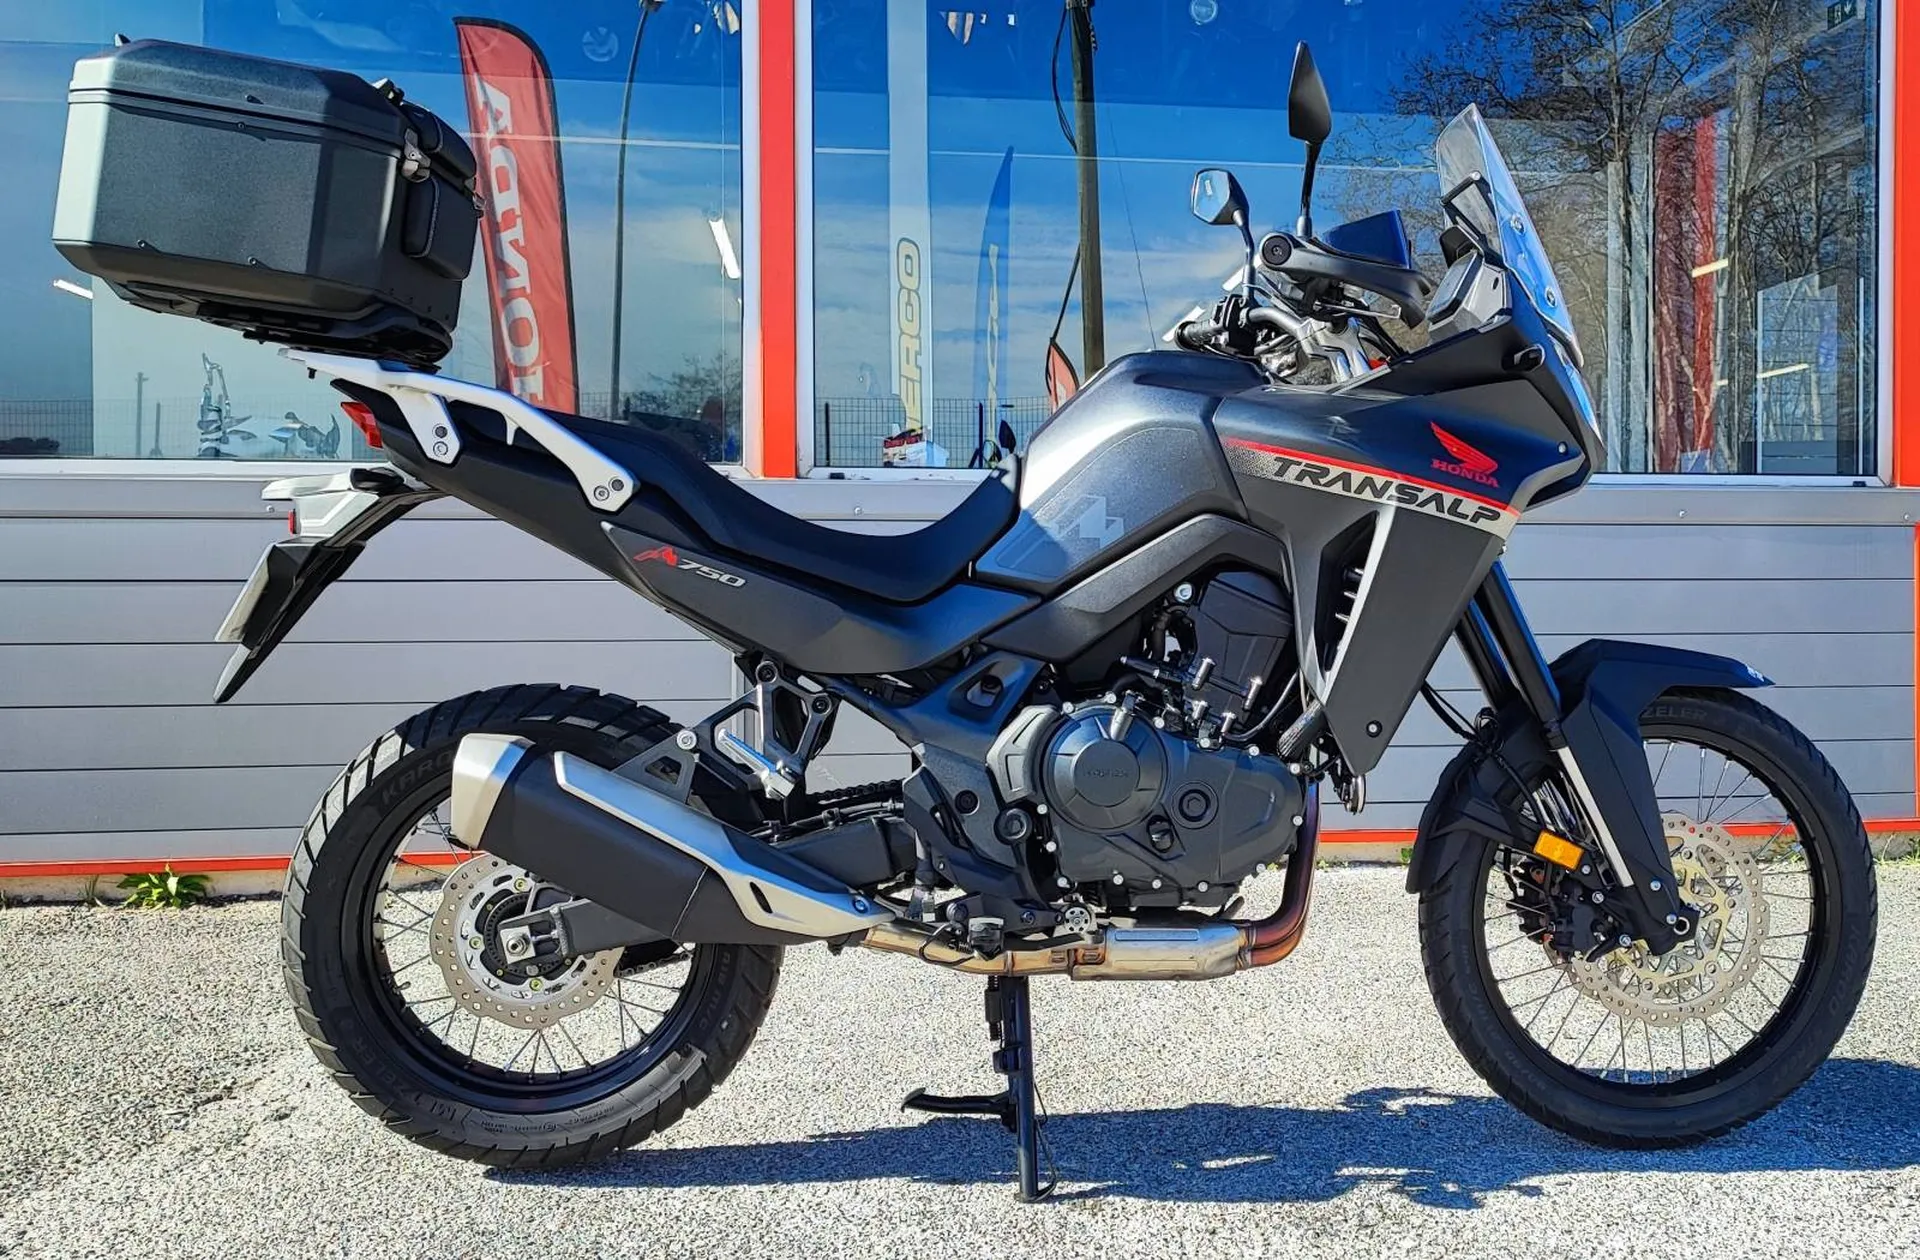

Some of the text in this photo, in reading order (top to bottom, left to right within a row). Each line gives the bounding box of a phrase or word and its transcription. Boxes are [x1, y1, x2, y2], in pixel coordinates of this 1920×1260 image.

[1431, 459, 1498, 487] HONDA
[1273, 457, 1501, 523] TRANSALP
[678, 558, 746, 587] 750
[1641, 705, 1707, 720] ZELER
